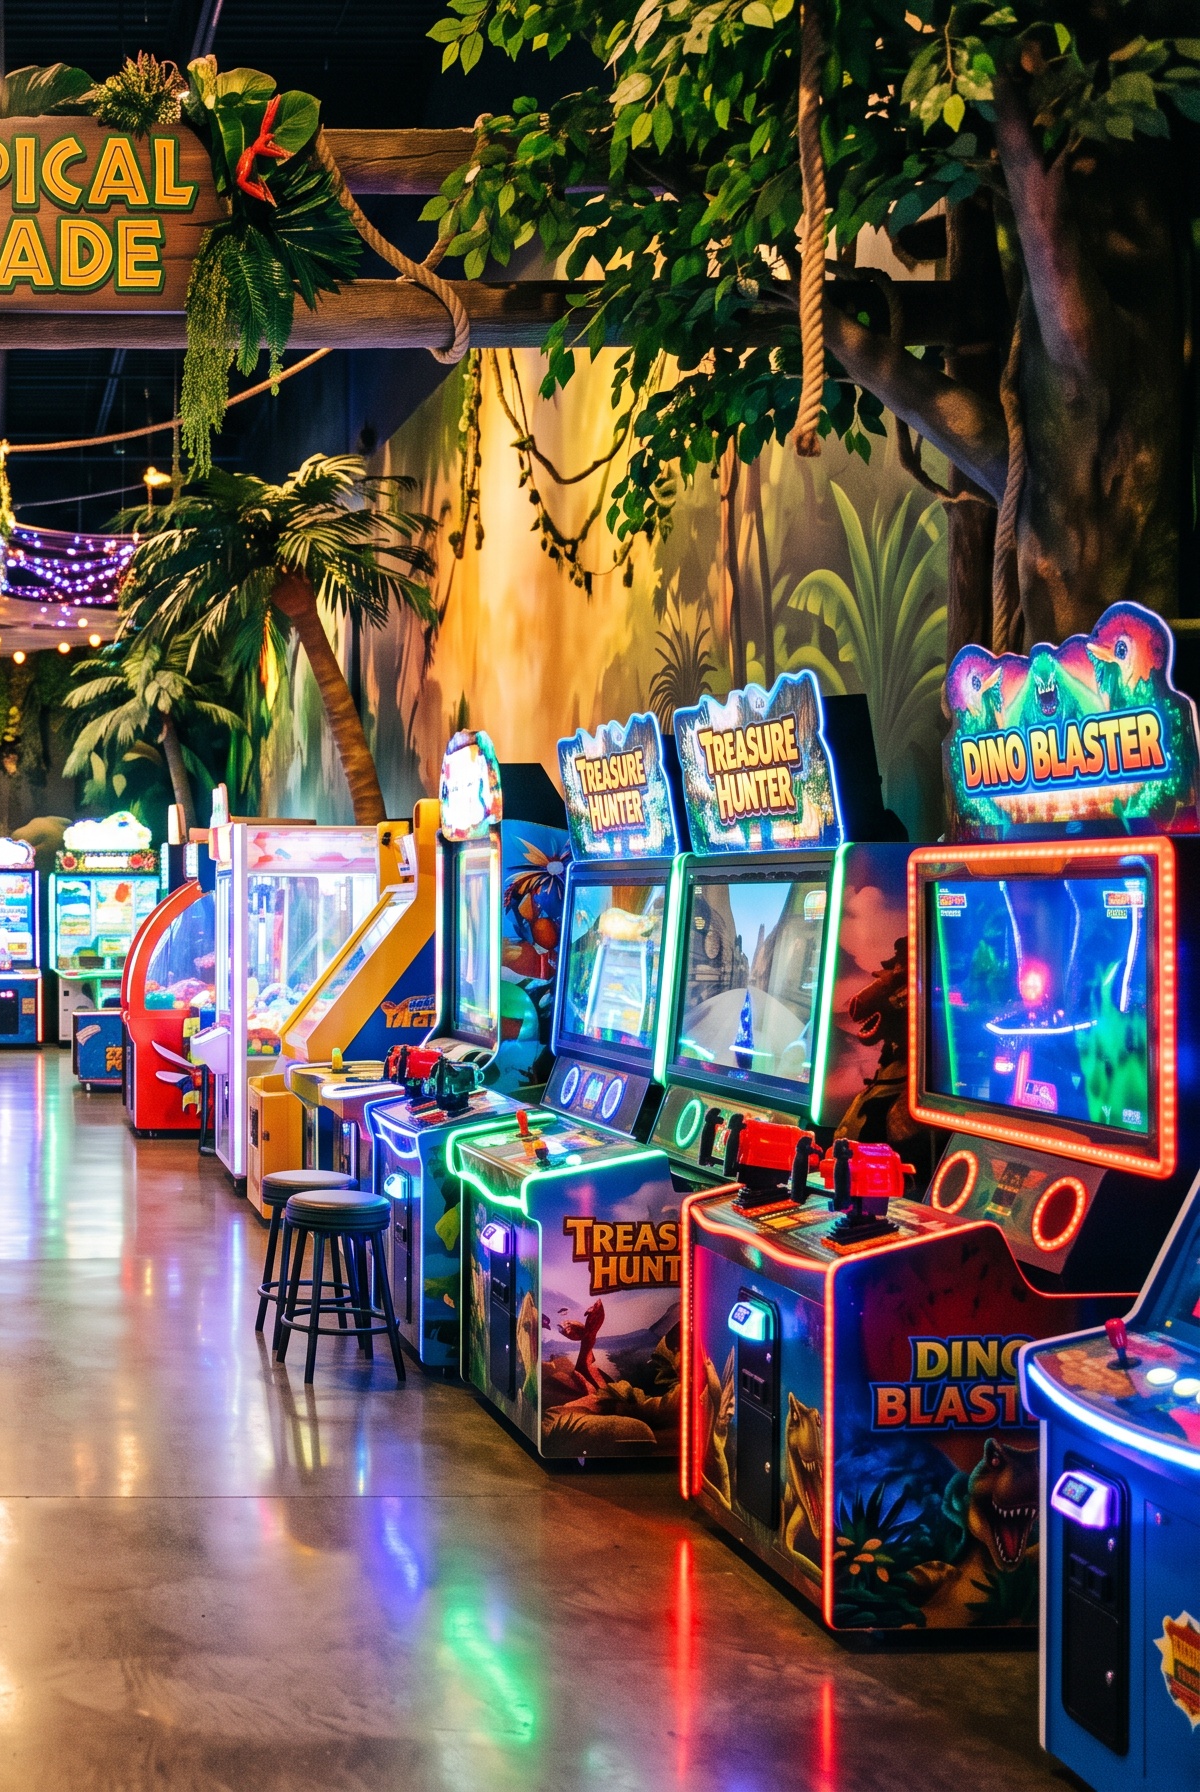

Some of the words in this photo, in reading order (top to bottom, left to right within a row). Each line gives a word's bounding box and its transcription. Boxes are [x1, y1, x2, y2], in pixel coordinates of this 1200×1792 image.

[698, 718, 799, 775] TREASURE
[961, 733, 1027, 787] DINO
[1029, 713, 1164, 780] BLASTER
[575, 750, 646, 795] TREASURE
[714, 766, 795, 820] HUNTER
[588, 789, 644, 832] HUNTER
[565, 1219, 682, 1256] TREAS
[876, 1385, 1040, 1425] BLAST
